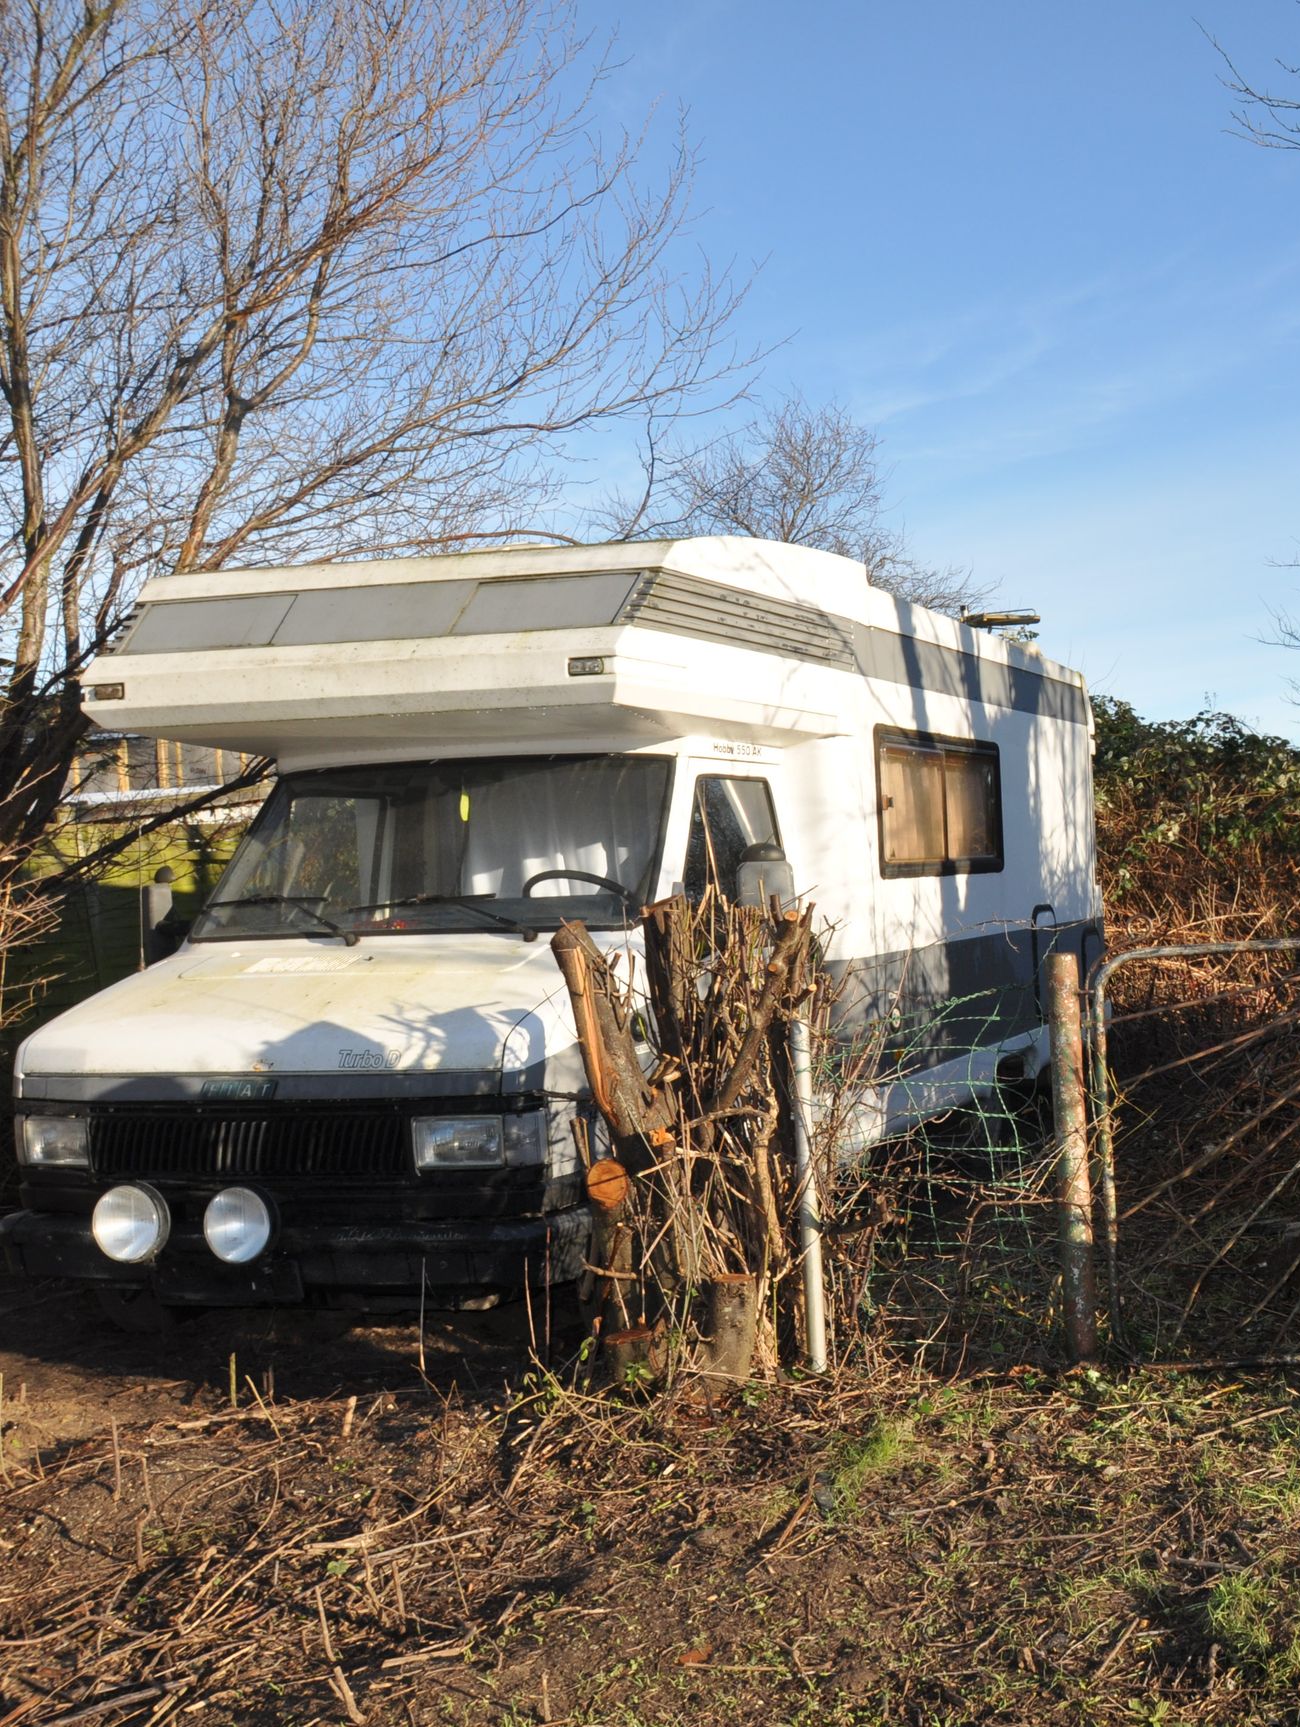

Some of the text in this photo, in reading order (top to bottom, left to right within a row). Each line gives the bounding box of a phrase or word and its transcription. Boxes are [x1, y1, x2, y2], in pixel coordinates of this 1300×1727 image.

[713, 742, 734, 755] Hobby
[737, 744, 751, 756] 550
[338, 1049, 402, 1069] Turbo D
[208, 1084, 271, 1097] FIAT
